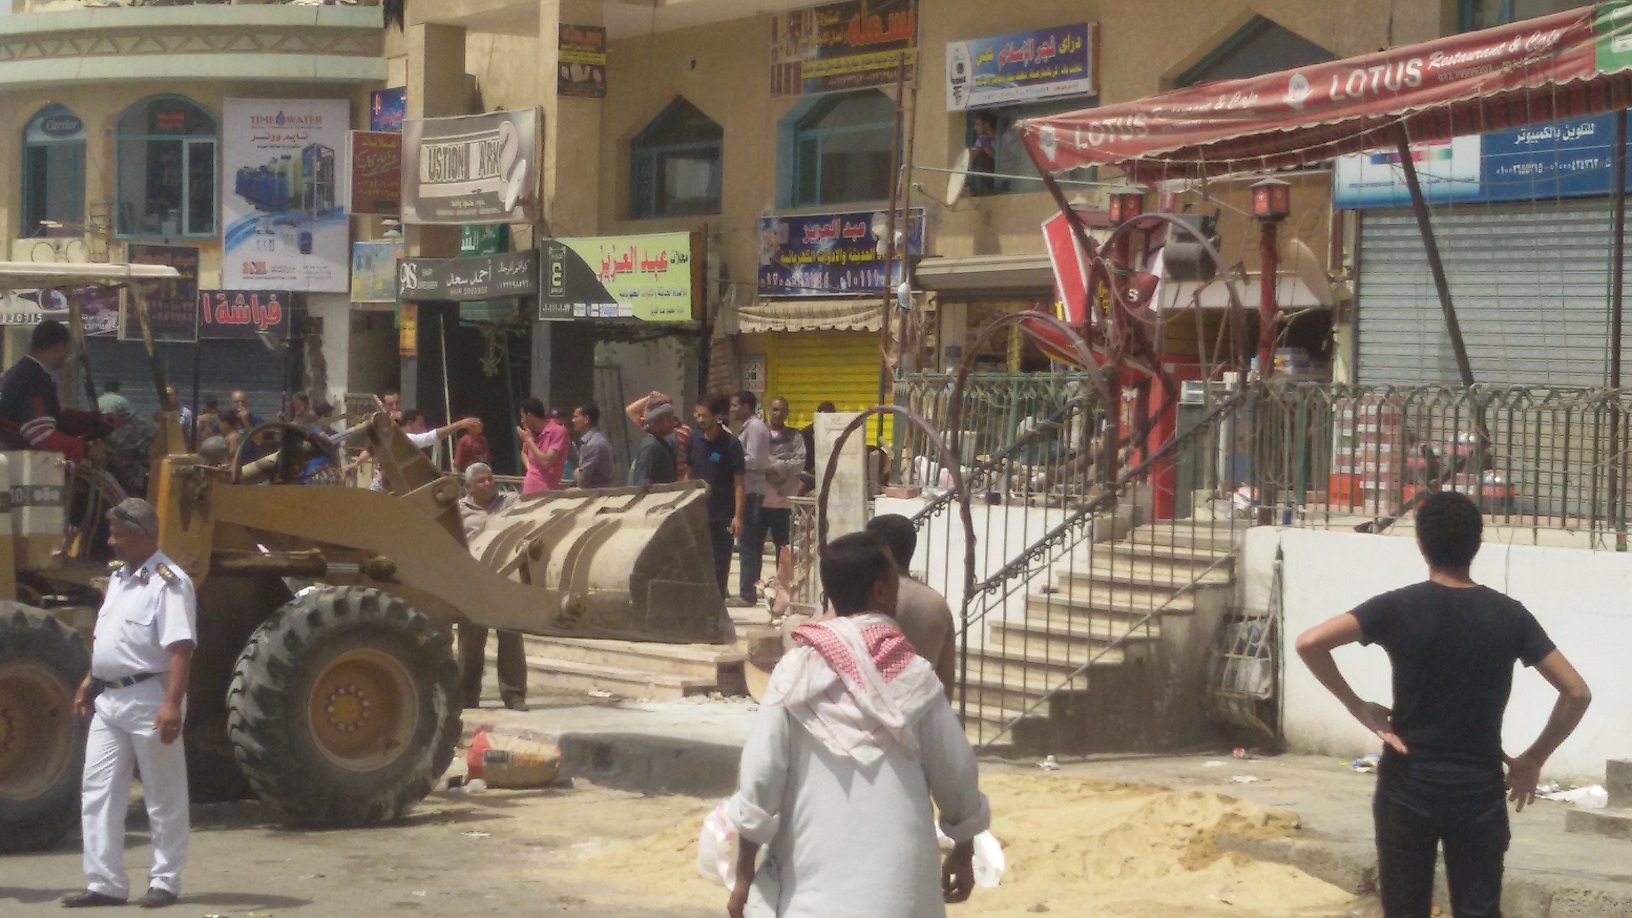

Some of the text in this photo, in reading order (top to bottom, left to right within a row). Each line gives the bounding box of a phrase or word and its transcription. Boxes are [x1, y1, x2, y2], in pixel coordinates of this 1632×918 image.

[1330, 58, 1423, 100] LOTUS
[1427, 42, 1506, 70] Restaurant
[1508, 34, 1522, 53] &
[46, 118, 79, 131] Carrier
[250, 115, 323, 125] TIME WATER
[1074, 113, 1149, 150] LOTUS
[446, 259, 492, 288] أحمد سعد
[596, 244, 638, 283] العزيز
[641, 249, 668, 282] عبد
[214, 293, 282, 331] فراشة
